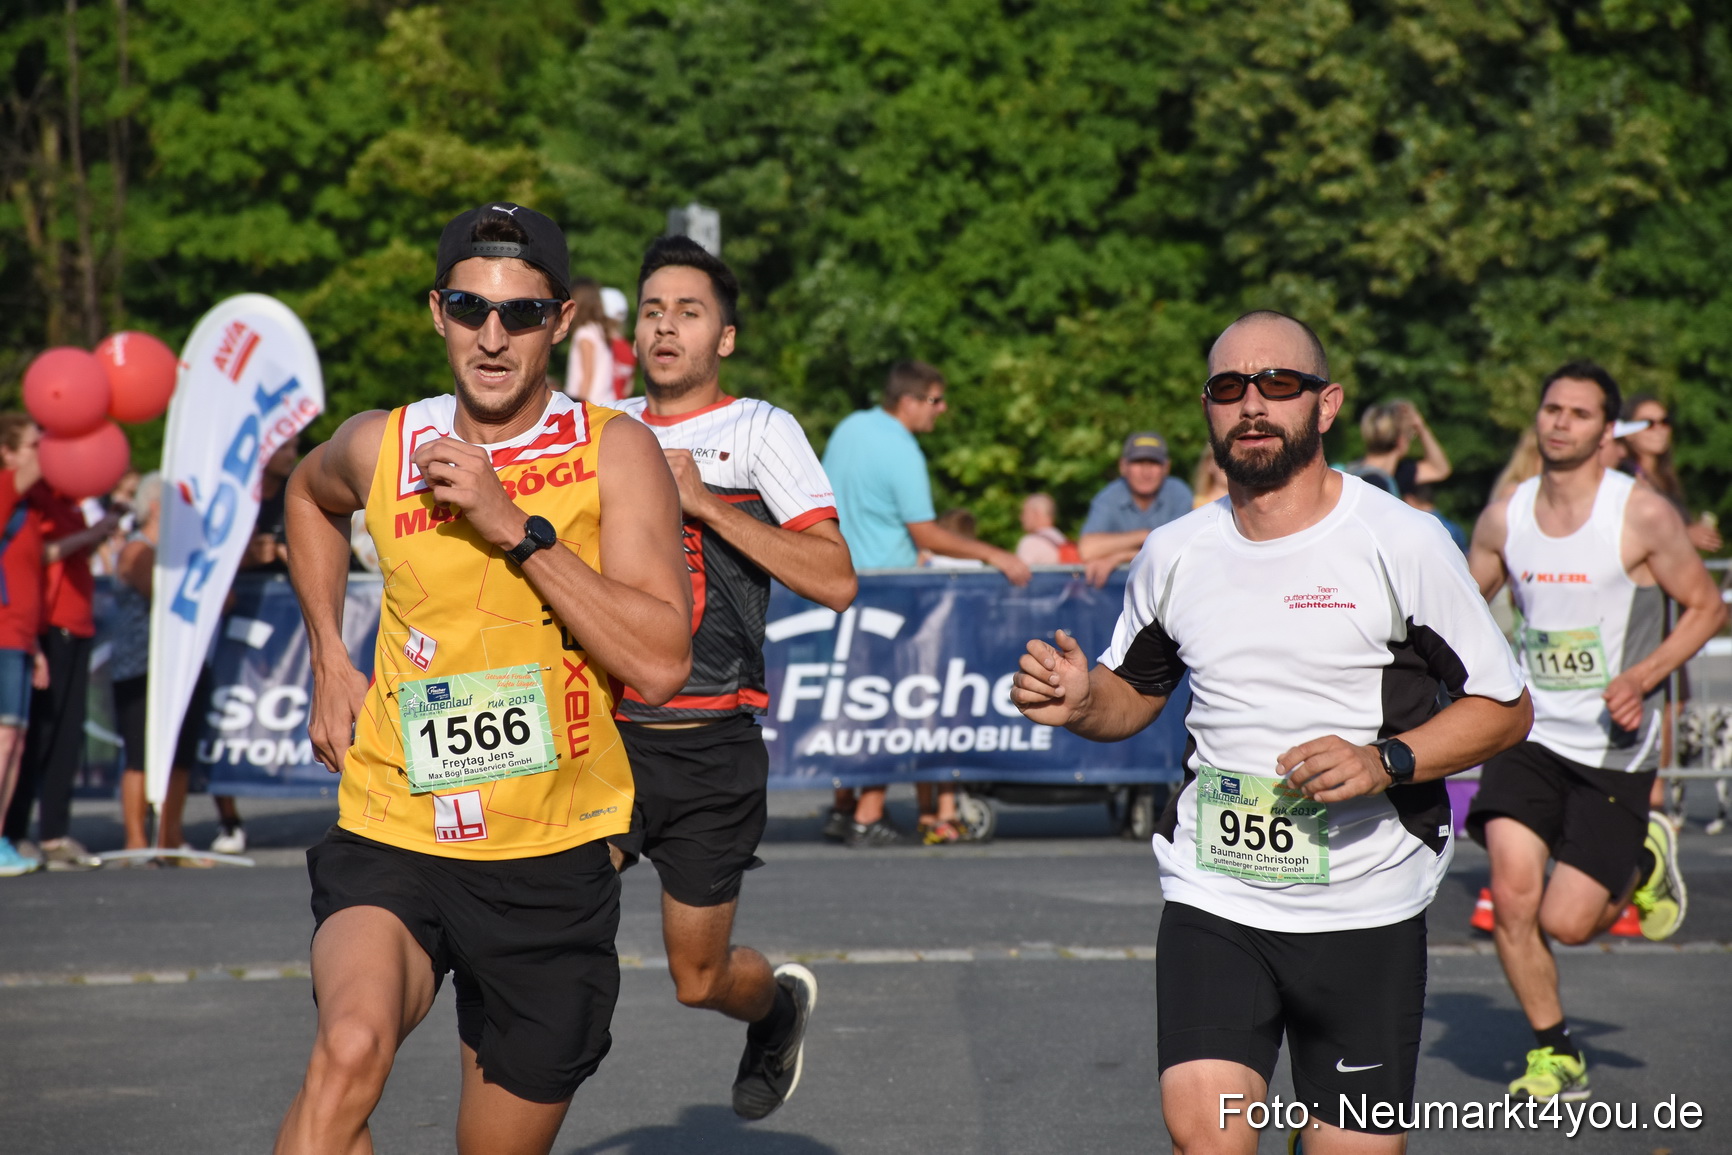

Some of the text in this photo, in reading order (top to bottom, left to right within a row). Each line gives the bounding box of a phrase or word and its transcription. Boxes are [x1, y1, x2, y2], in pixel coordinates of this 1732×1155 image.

[1283, 593, 1333, 603] guttenberger
[1316, 586, 1339, 594] Team
[1536, 651, 1595, 674] 1149
[508, 693, 535, 706] 2019
[776, 657, 1025, 723] Fische
[419, 693, 473, 713] firmenlauf
[419, 706, 531, 759] 1566
[805, 725, 1054, 757] AUTOMOBILE
[442, 750, 515, 769] Freytag Jens
[464, 763, 507, 775] Bauservice
[508, 757, 533, 767] GmbH
[1213, 789, 1259, 807] firmenlauf
[1290, 807, 1318, 816] 2019
[1219, 809, 1294, 853] 956
[1210, 845, 1309, 867] Baumann Christoph
[1213, 857, 1253, 870] guttenberger
[1254, 862, 1280, 873] partner
